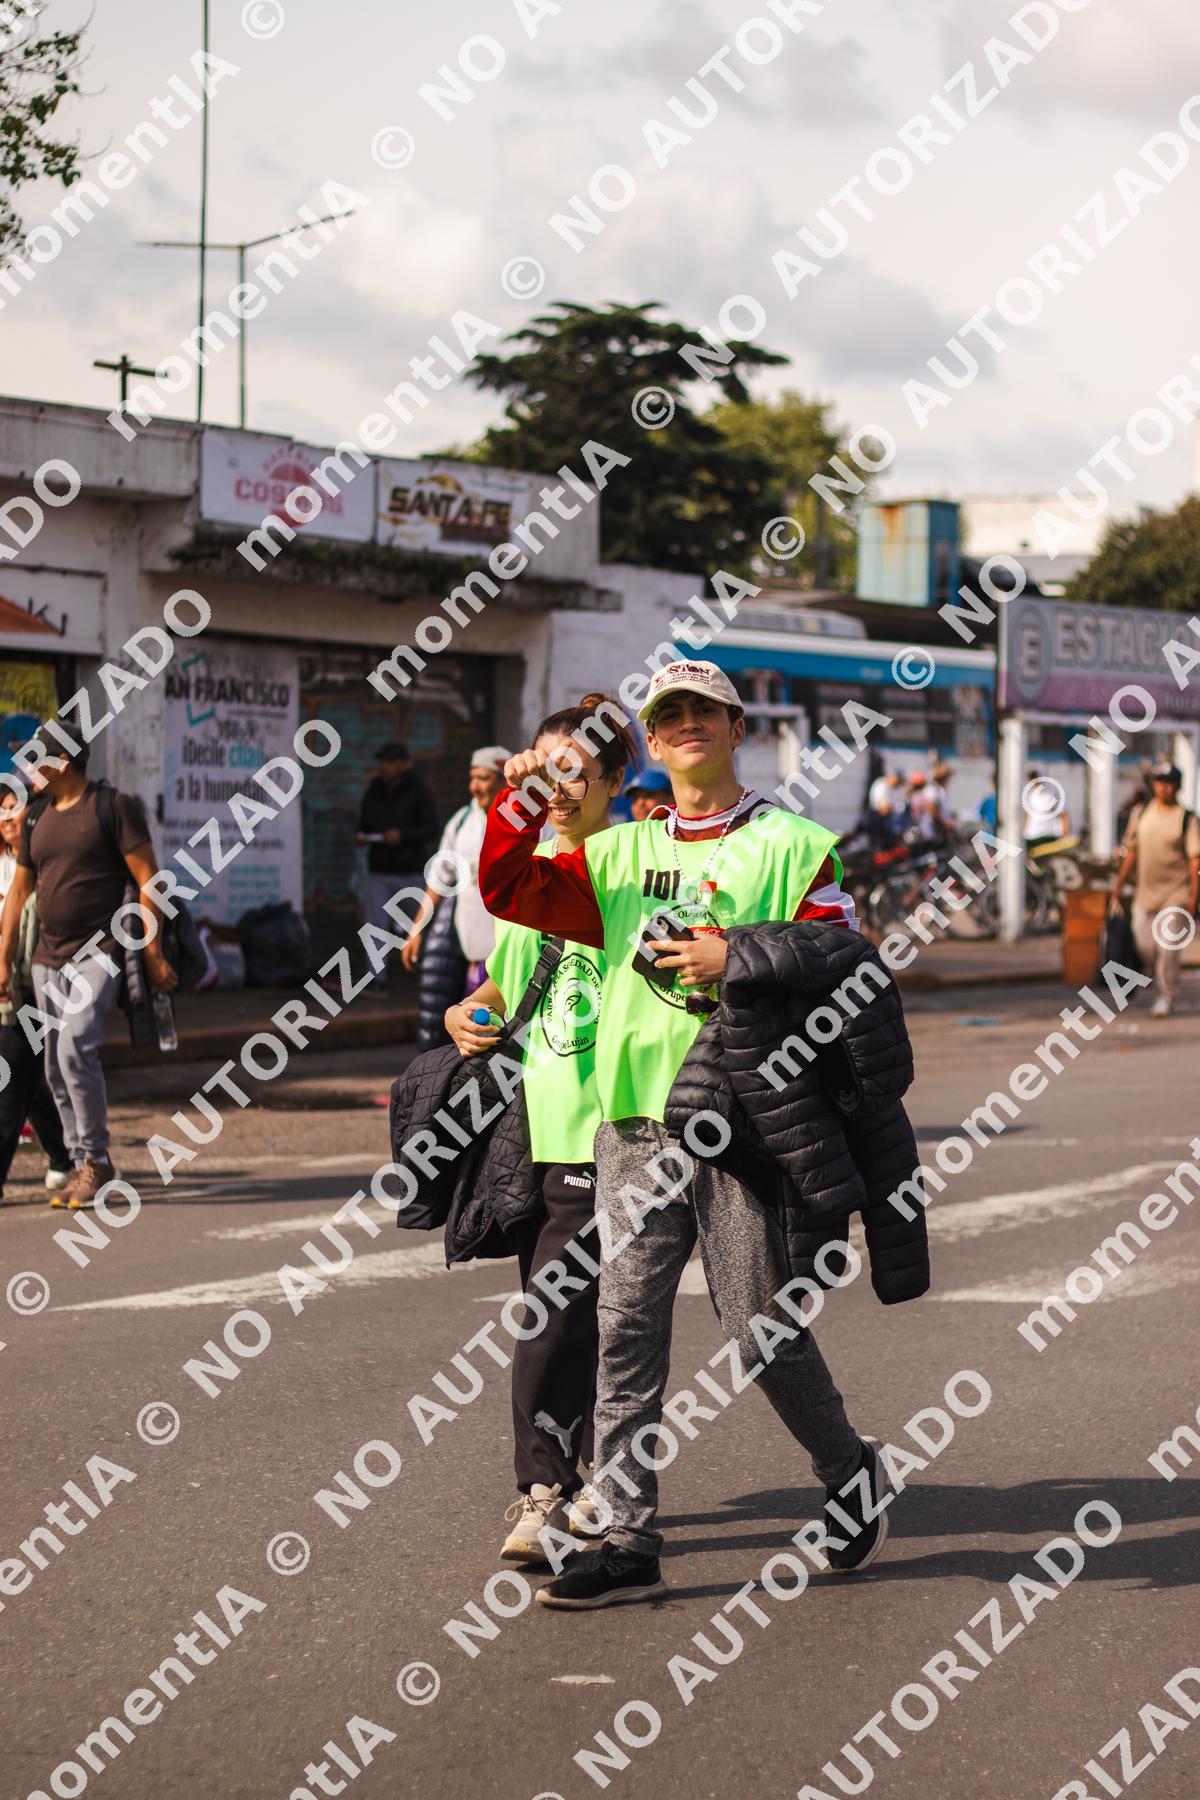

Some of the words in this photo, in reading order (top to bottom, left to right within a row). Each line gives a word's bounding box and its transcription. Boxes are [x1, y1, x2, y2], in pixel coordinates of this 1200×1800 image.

[1053, 608, 1200, 676] ESTACIO
[195, 677, 290, 707] FRANCISCO
[563, 1174, 592, 1189] PUMA
